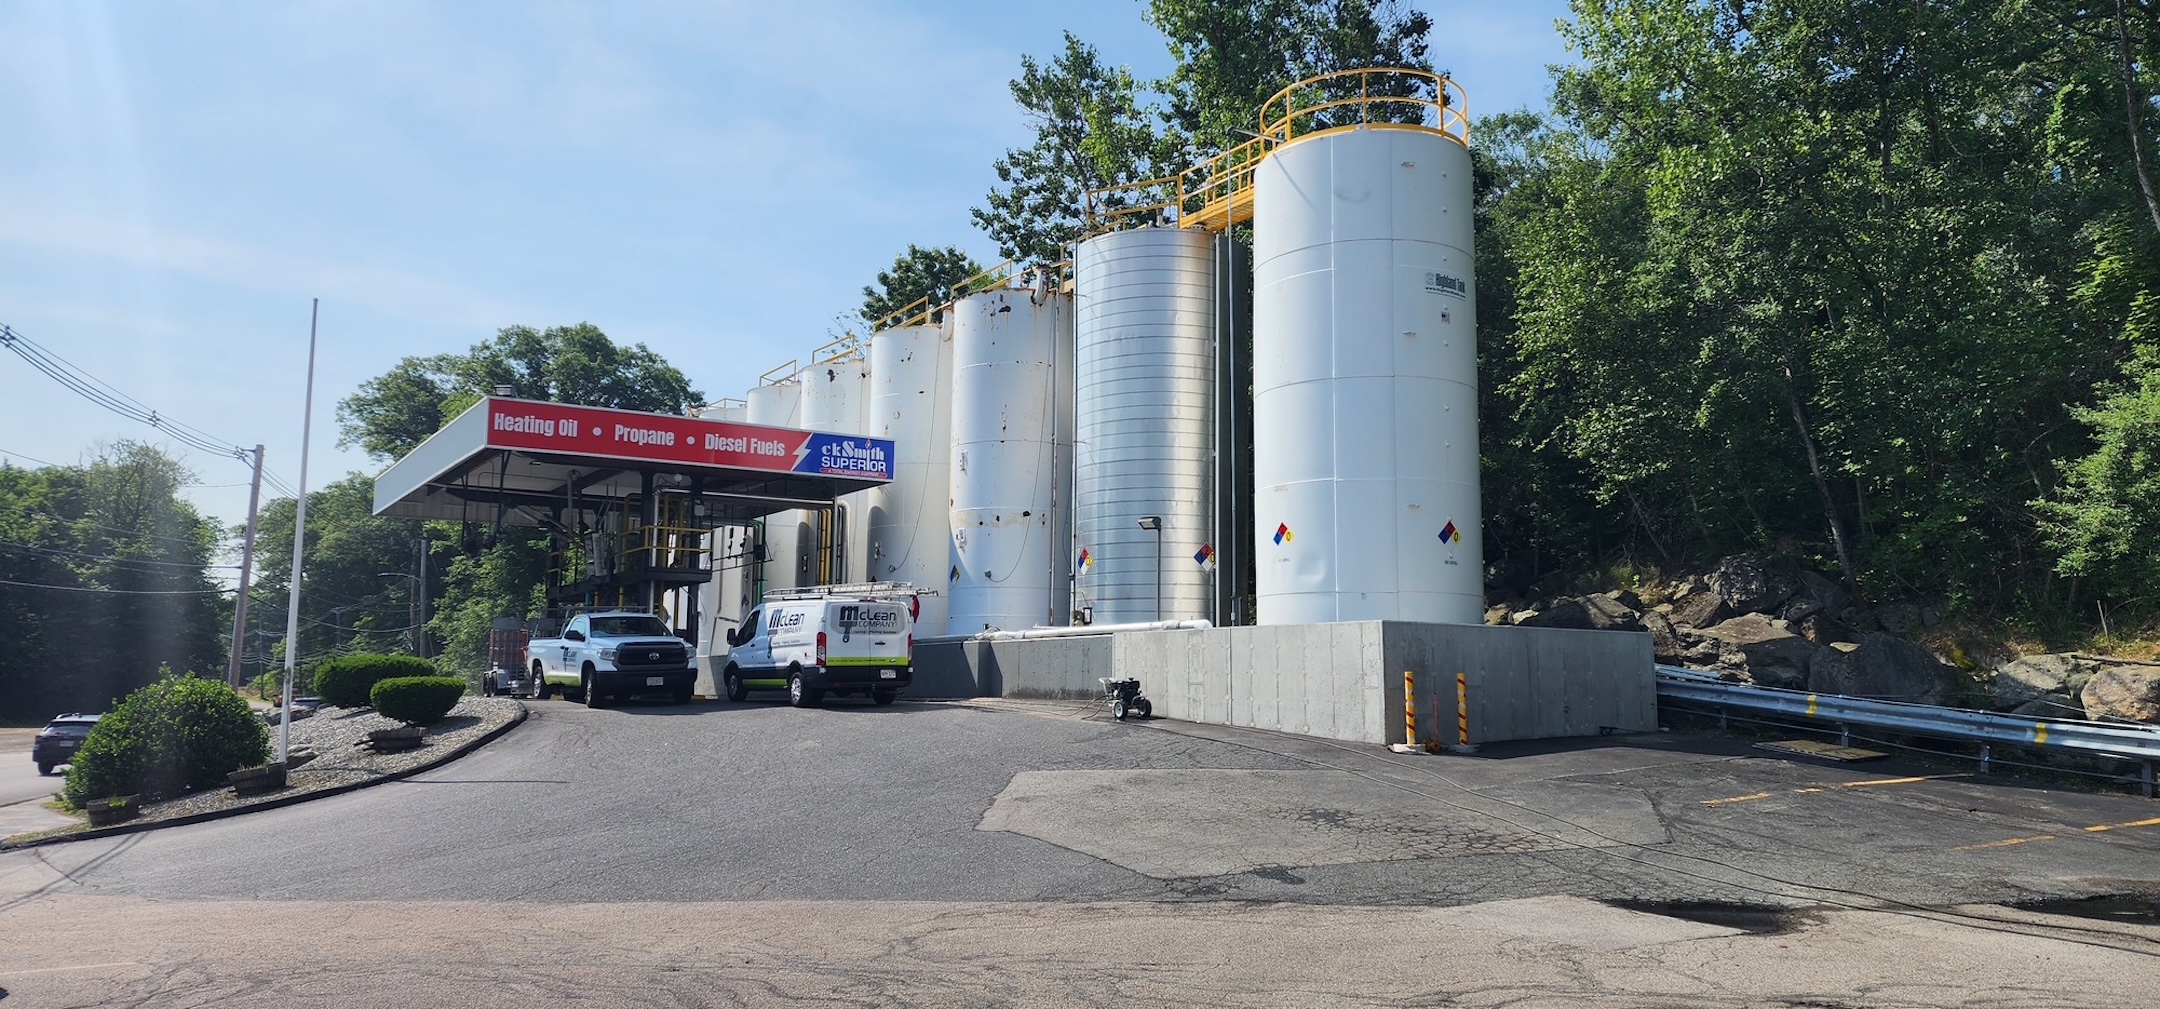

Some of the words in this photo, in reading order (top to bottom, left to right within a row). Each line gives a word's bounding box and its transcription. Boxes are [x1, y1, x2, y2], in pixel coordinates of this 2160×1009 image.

[494, 412, 555, 437] Heating
[558, 419, 578, 438] Oil
[614, 424, 675, 447] Propane
[704, 433, 747, 454] Diesel
[750, 438, 786, 457] Fuels
[821, 456, 887, 472] SUPERIOR
